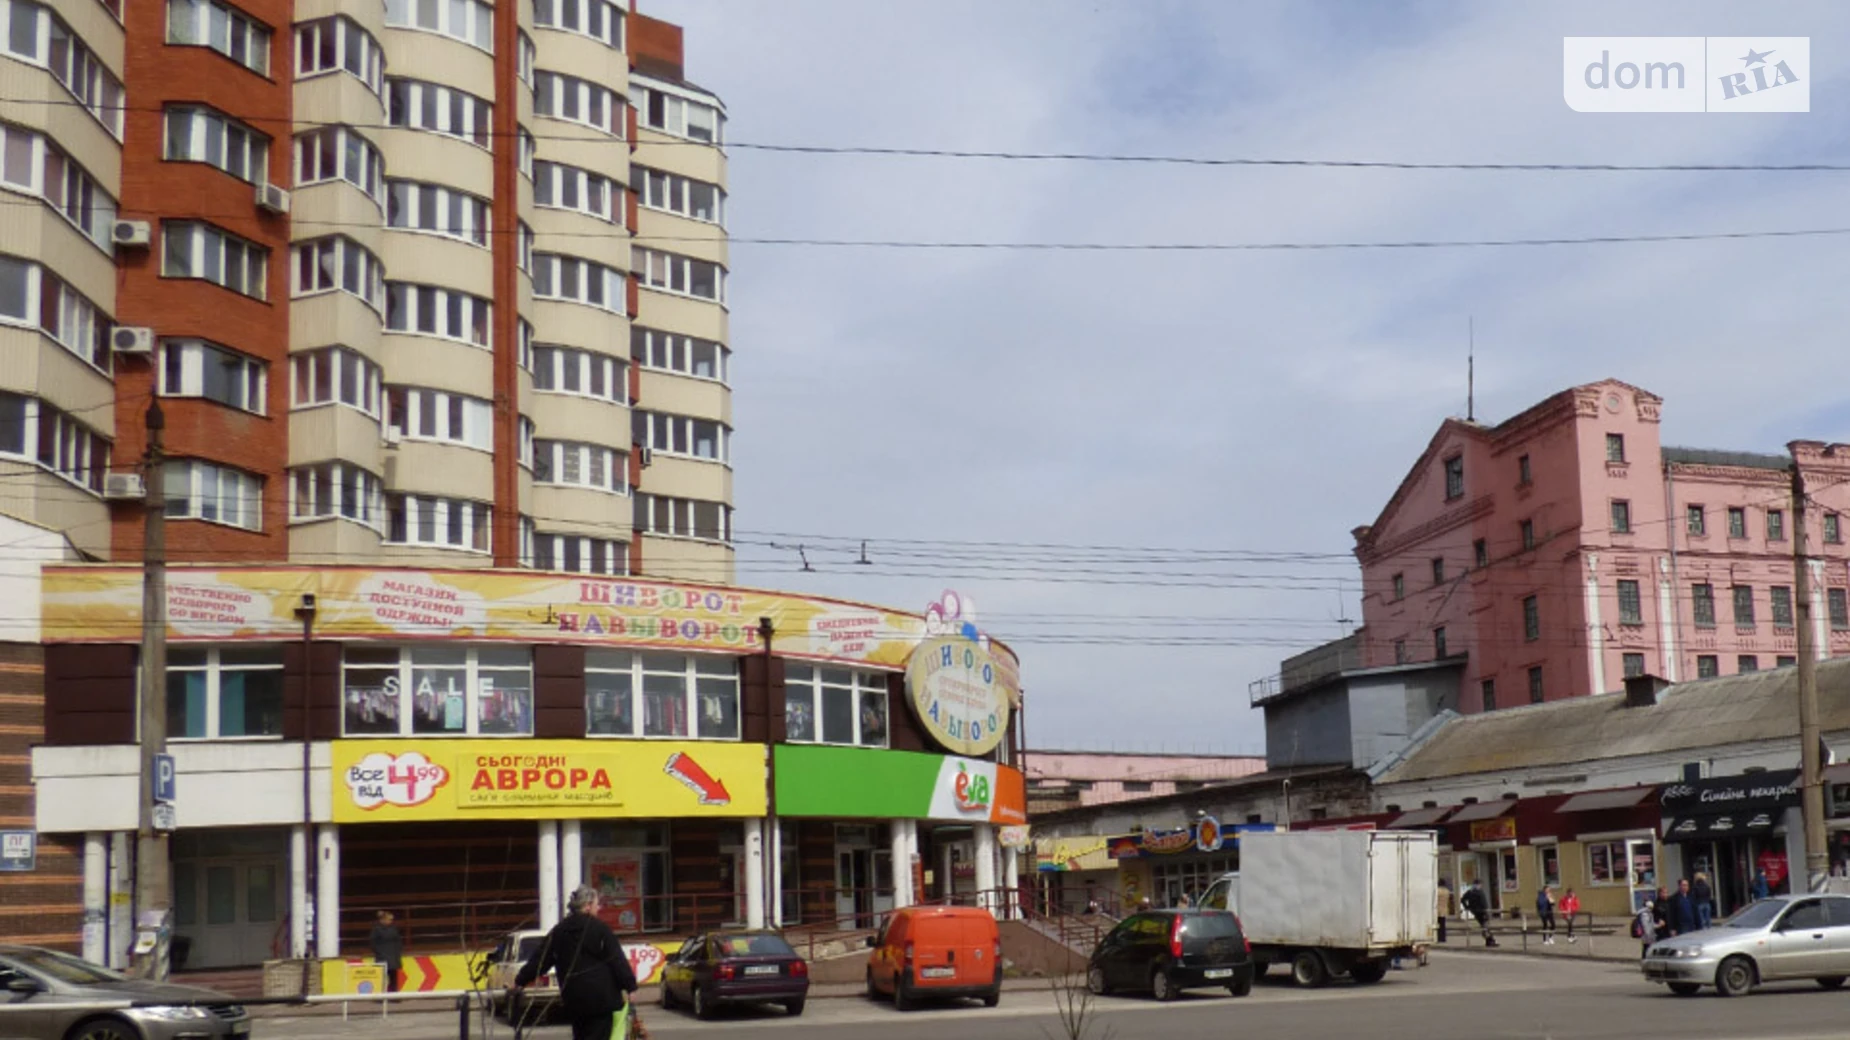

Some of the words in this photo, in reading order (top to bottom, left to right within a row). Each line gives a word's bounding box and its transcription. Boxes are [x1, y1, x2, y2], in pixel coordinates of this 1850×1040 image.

[383, 581, 457, 601] МАГАЗИН
[580, 583, 742, 613] ШИВОРОТ
[369, 593, 464, 616] ДОСТУПНОЙ
[558, 614, 757, 644] НАВЫВОРОТ
[383, 676, 494, 697] SALE
[159, 760, 173, 794] P
[471, 769, 612, 790] АВРОРА
